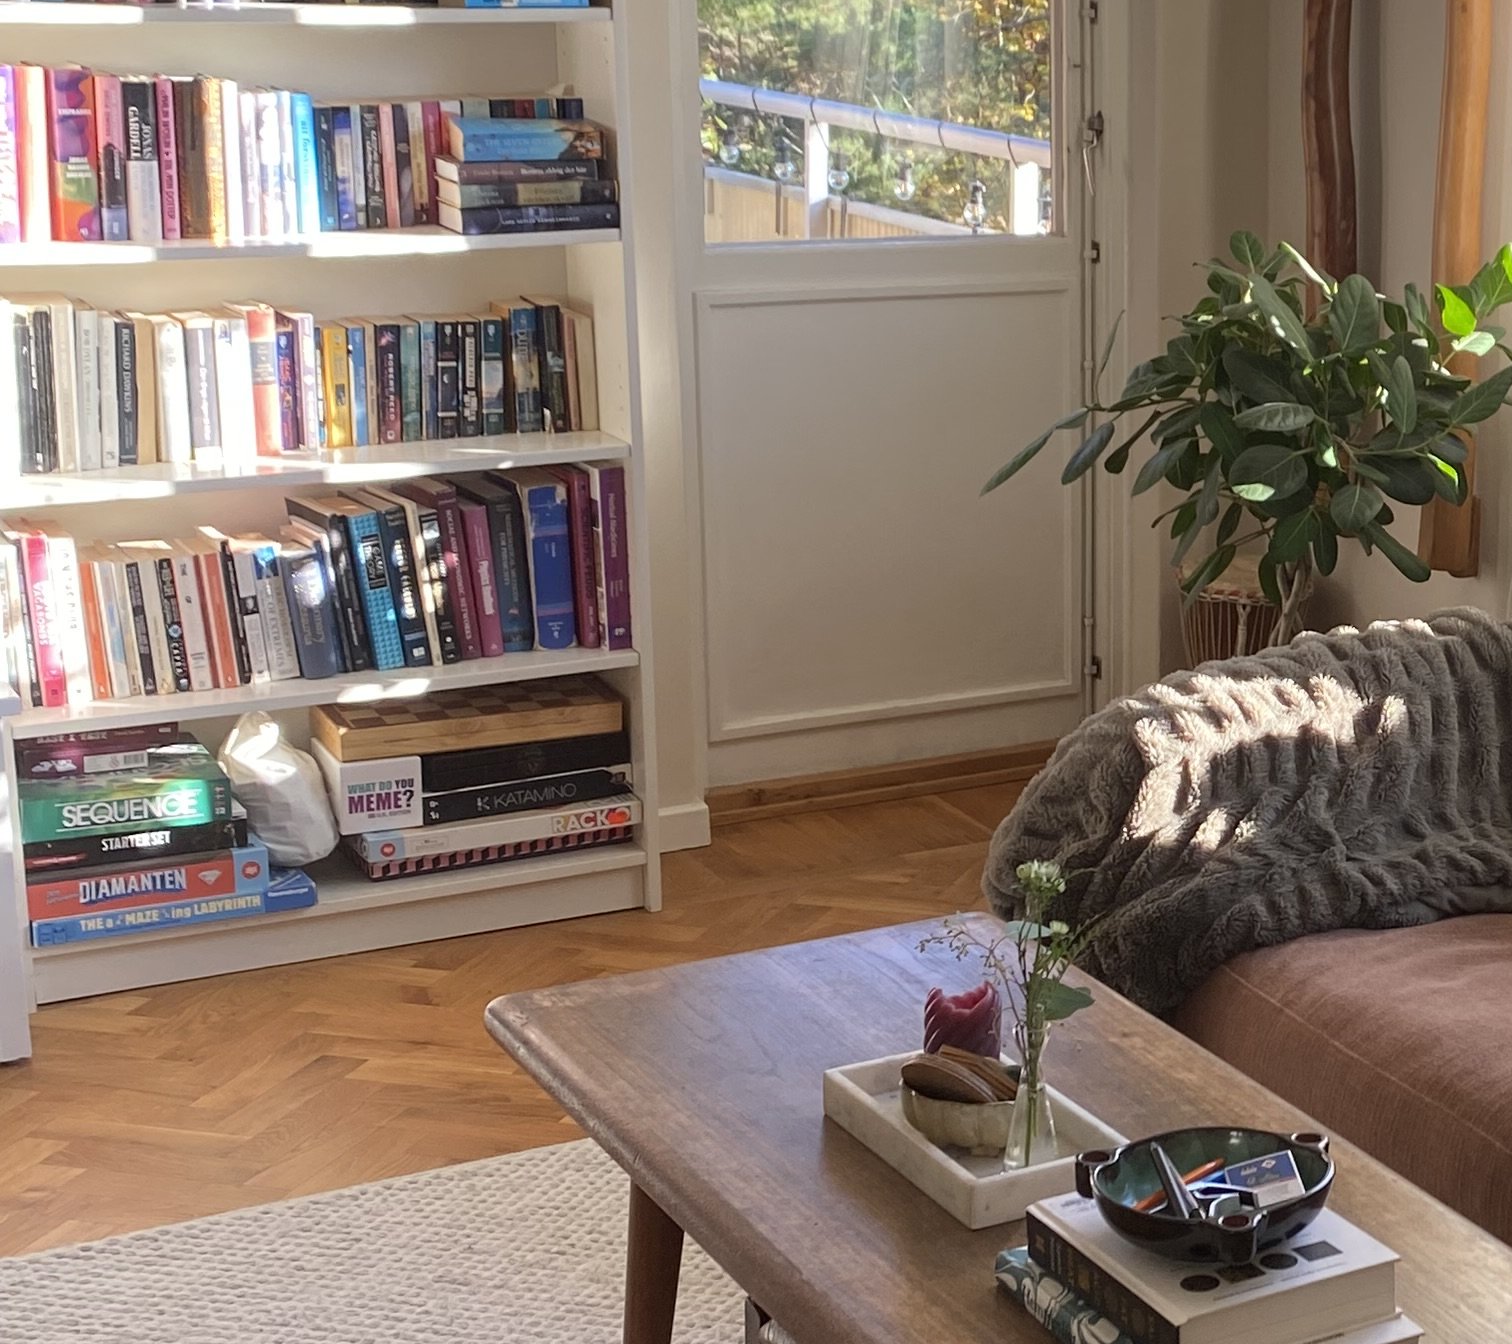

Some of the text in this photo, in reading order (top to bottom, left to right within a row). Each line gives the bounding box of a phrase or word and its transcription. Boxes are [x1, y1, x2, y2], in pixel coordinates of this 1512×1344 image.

[128, 106, 141, 160] GARDELL
[142, 123, 153, 160] JONAS
[121, 328, 132, 414] RICHARD DAWKINS
[387, 353, 395, 393] ROBERT
[608, 519, 618, 558] Medicines
[363, 544, 376, 579] THEORY
[372, 545, 384, 575] GAME
[460, 597, 472, 640] NETWORKS
[347, 778, 414, 794] WHAT DO YOU
[348, 789, 414, 814] MEME?
[492, 783, 577, 807] KATAMINO
[62, 789, 199, 828] SEQUENCE
[101, 830, 172, 852] STARTER SET
[79, 868, 187, 904] DIAMANTEN
[80, 919, 104, 932] THE
[194, 895, 261, 916] LABYRINTH
